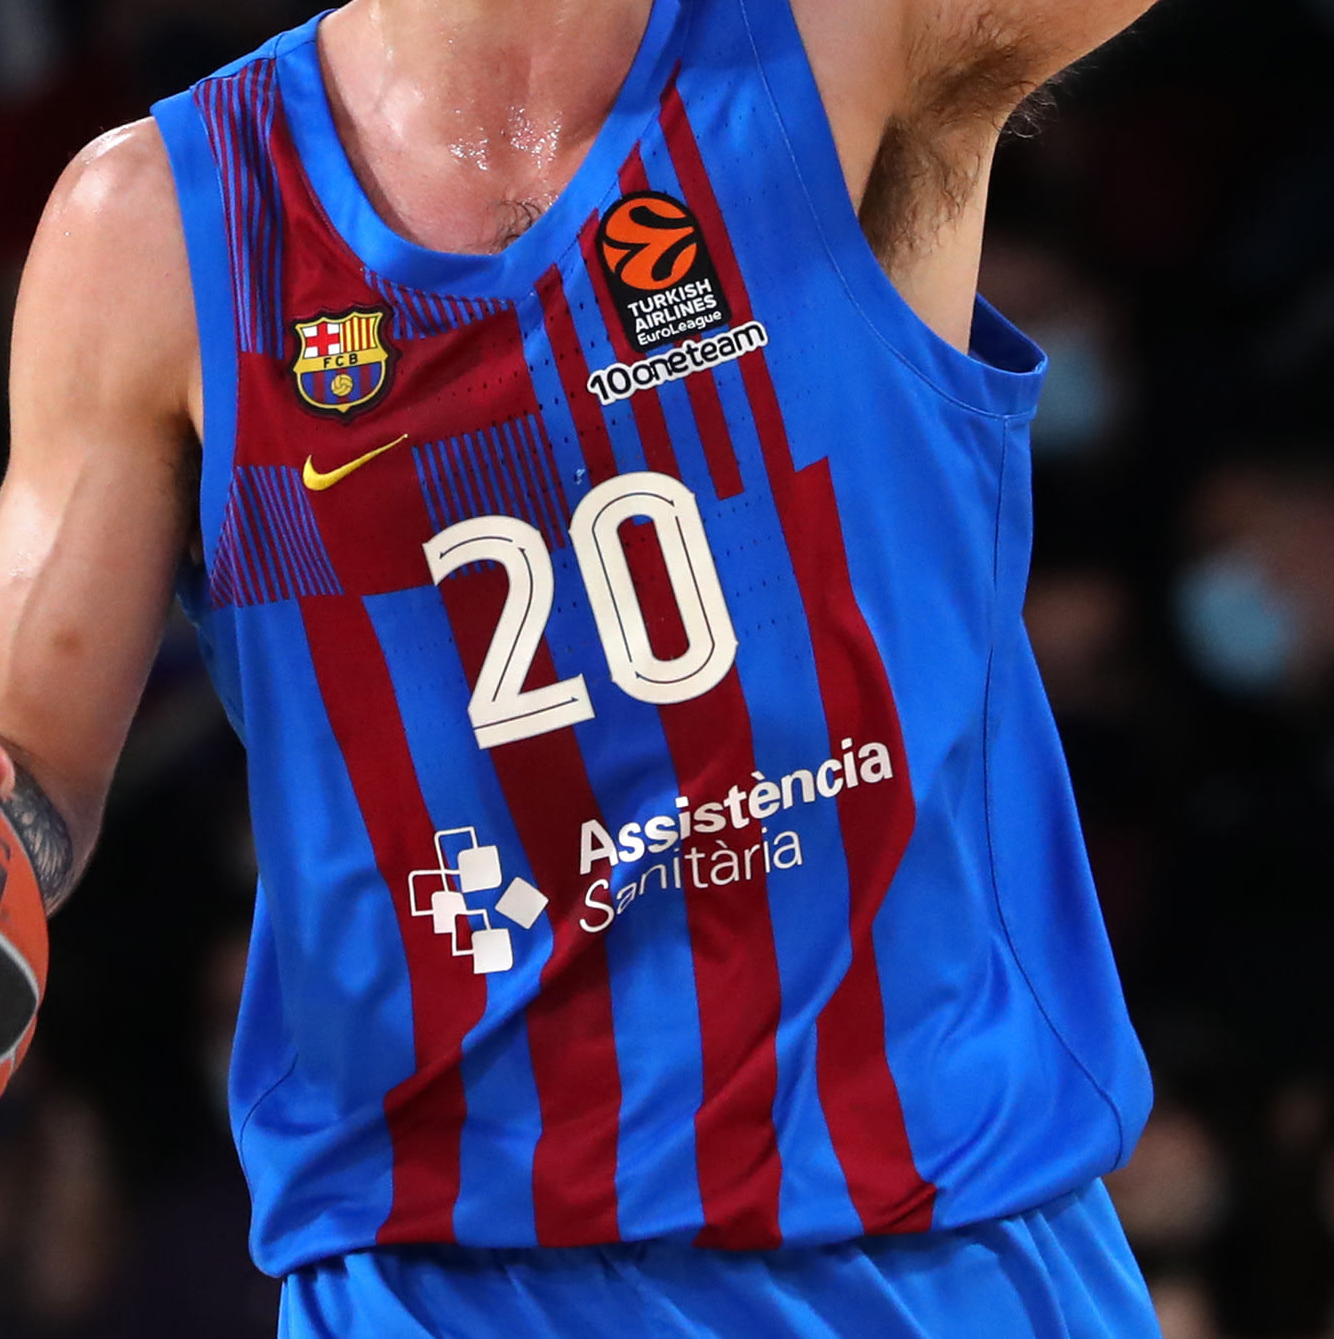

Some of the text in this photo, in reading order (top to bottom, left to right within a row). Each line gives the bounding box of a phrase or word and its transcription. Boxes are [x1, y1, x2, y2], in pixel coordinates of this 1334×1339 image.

[627, 278, 712, 317] TURKISH
[635, 294, 717, 333] AIRLINES
[637, 310, 722, 346] EuroLeague
[589, 323, 766, 401] 10oneteam
[422, 471, 738, 749] 20
[579, 737, 894, 875] Assistència
[579, 827, 804, 933] Sanitària
